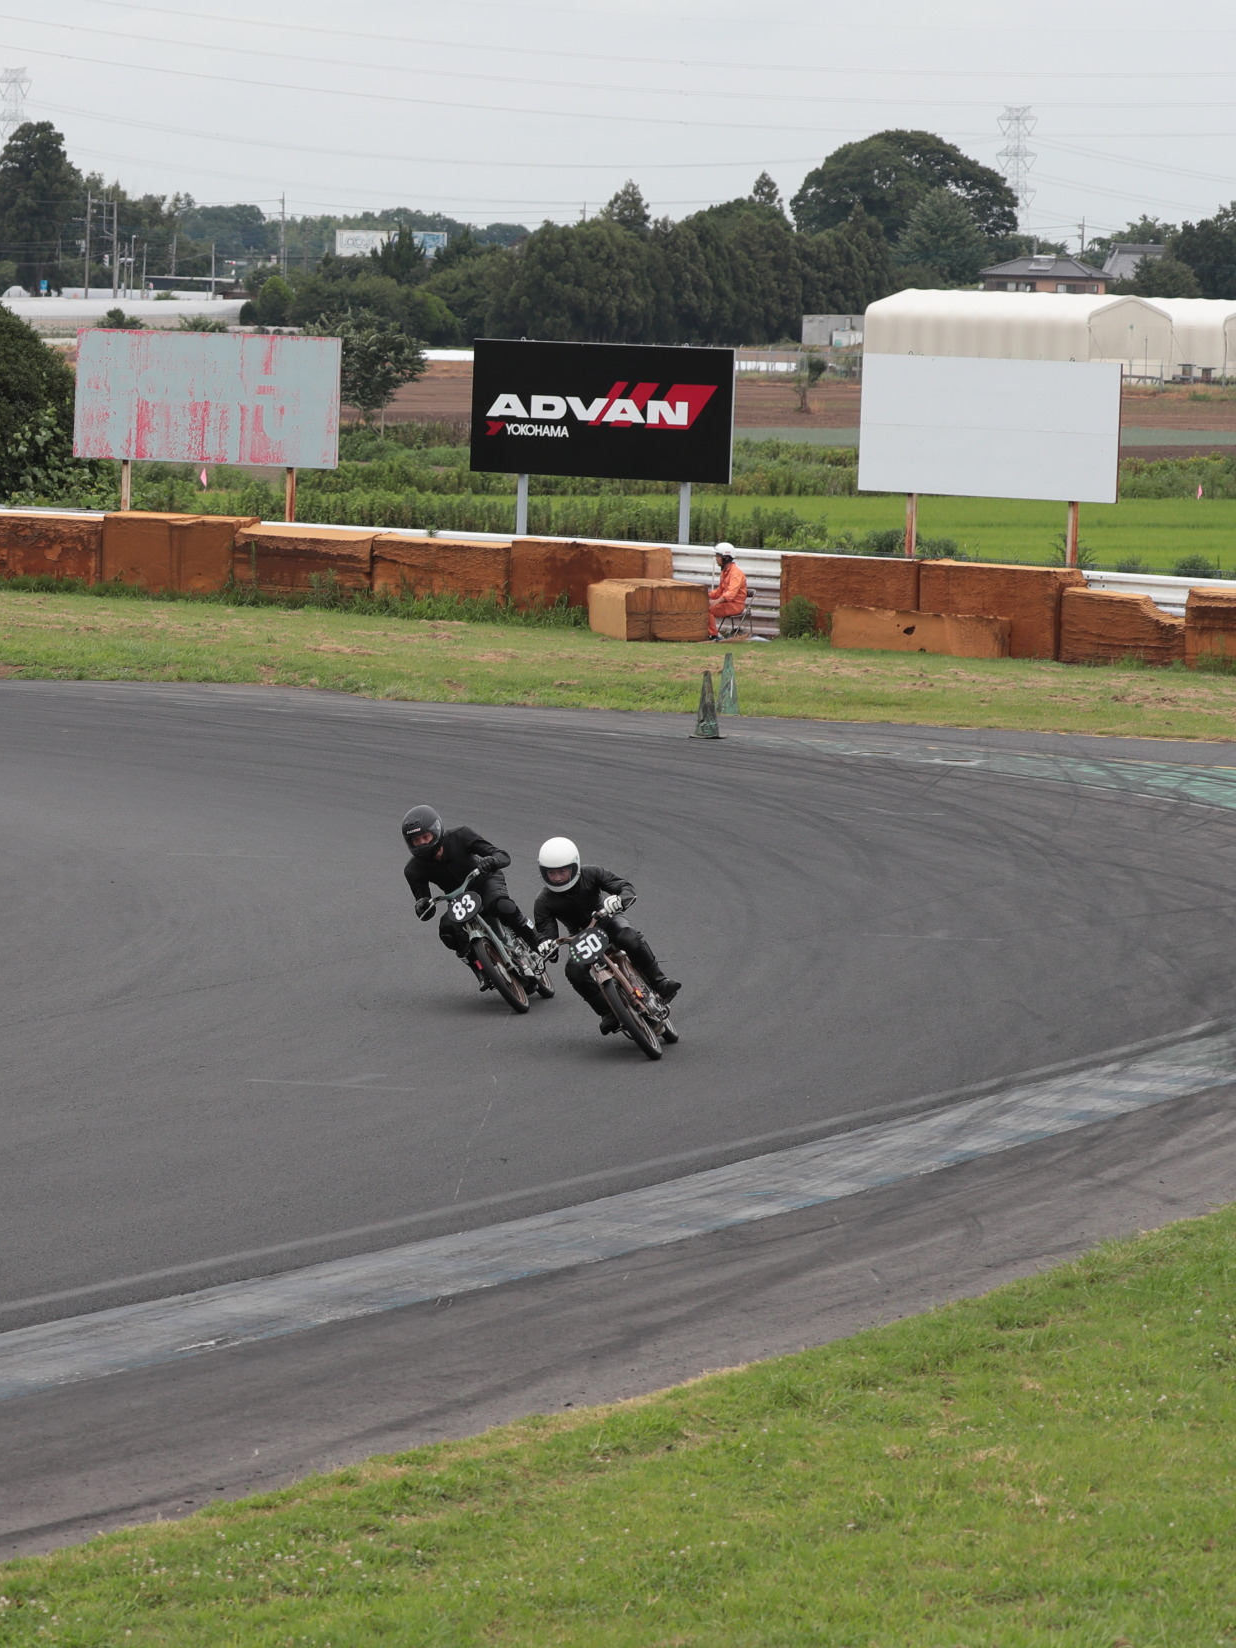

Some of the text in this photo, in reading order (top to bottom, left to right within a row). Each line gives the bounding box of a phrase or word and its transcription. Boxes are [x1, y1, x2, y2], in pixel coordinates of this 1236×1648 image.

[485, 393, 689, 426] ADVAN
[505, 422, 570, 438] YOKOHAMA
[452, 894, 476, 921] 83
[575, 933, 603, 959] 50
